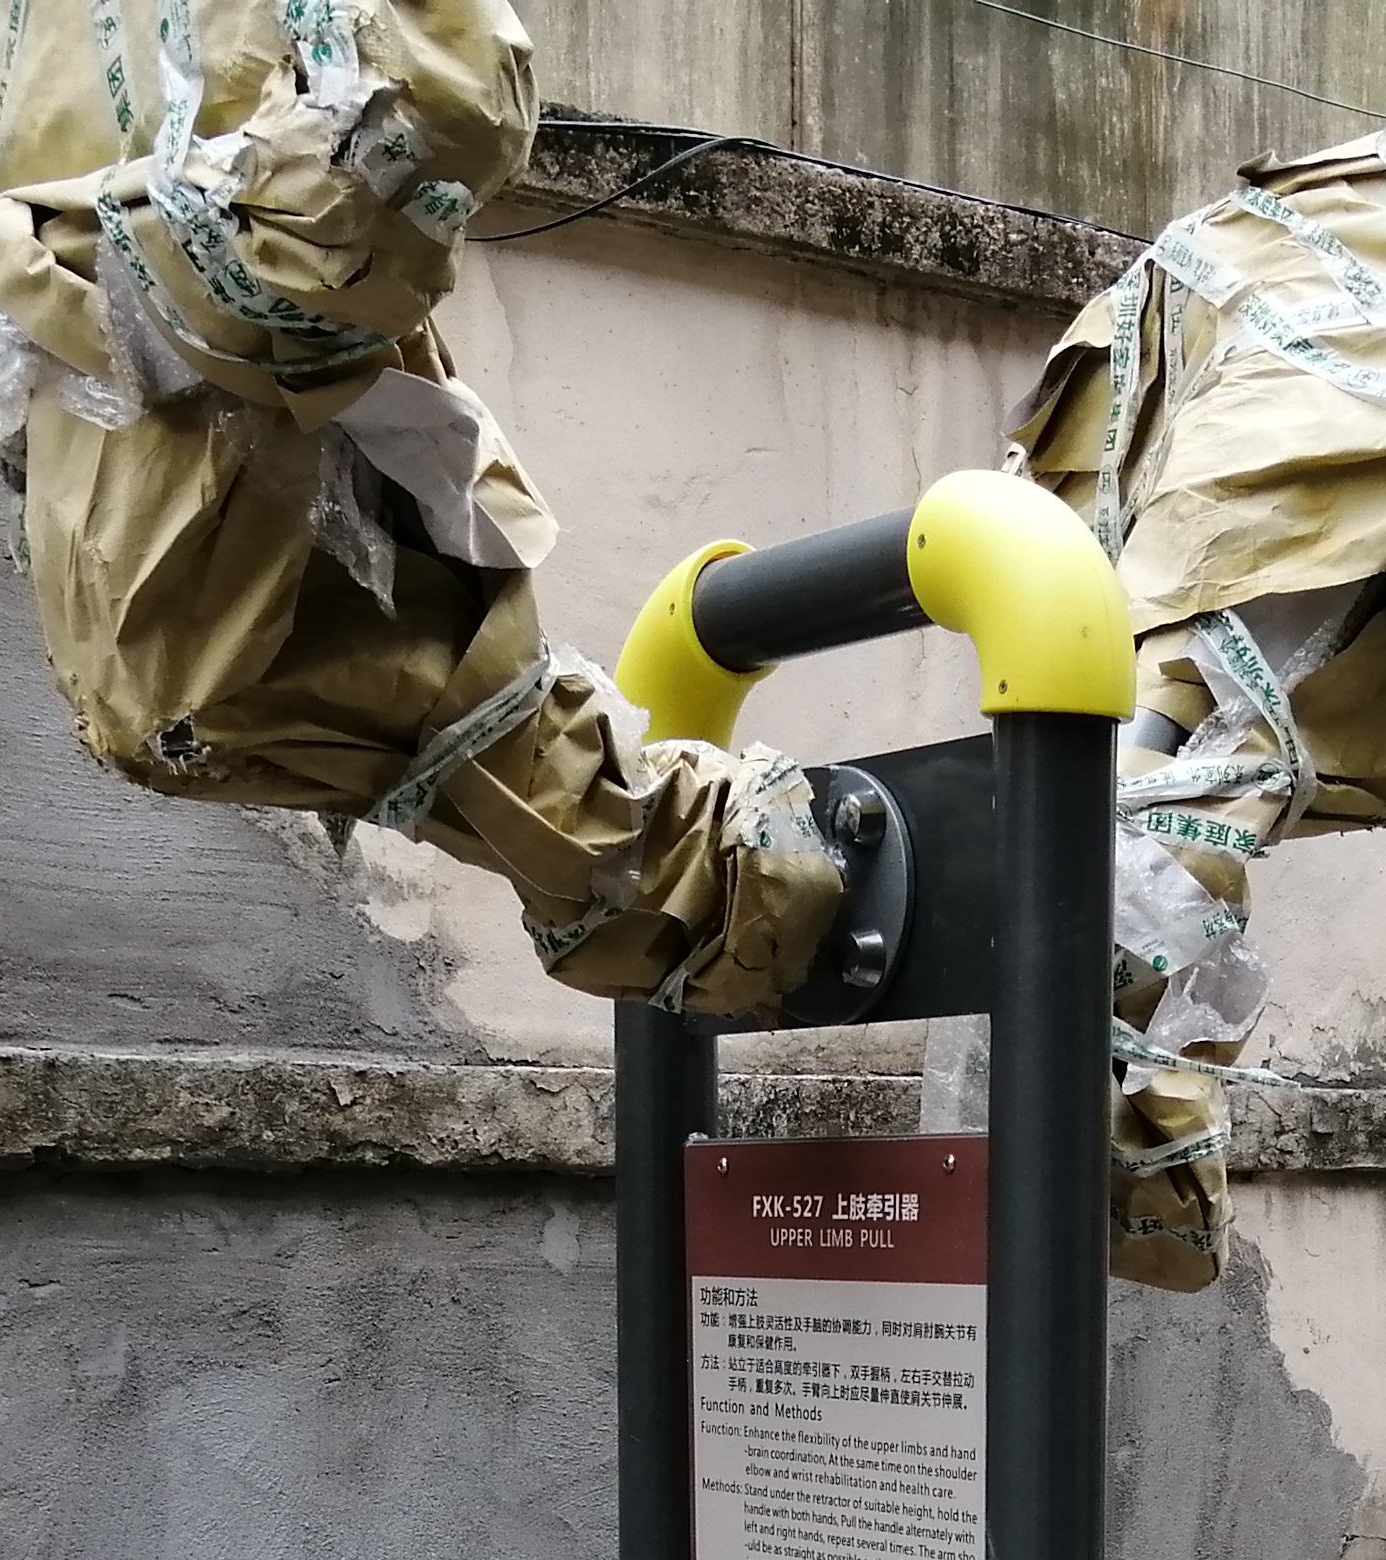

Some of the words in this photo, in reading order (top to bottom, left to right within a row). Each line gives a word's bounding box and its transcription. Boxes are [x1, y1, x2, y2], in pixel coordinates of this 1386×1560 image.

[1147, 811, 1258, 857] 家庭集团
[752, 1195, 824, 1218] FXK-527
[831, 1193, 920, 1222] 上肢牵引器
[770, 1228, 813, 1247] UPPER
[819, 1229, 854, 1248] LIMB
[860, 1229, 895, 1248] PULL
[700, 1286, 759, 1307] 功能和方法
[700, 1395, 745, 1414] Function
[749, 1401, 769, 1417] and
[774, 1401, 822, 1422] Methods
[700, 1419, 742, 1437] Function:
[743, 1424, 780, 1441] Enhance
[781, 1428, 796, 1443] the
[797, 1429, 841, 1451] flexibility
[841, 1434, 852, 1448] of
[853, 1435, 869, 1450] the
[870, 1440, 899, 1455] upper
[900, 1440, 928, 1456] limbs
[929, 1444, 949, 1458] and
[950, 1444, 976, 1461] hand
[744, 1462, 771, 1477] elbow
[772, 1466, 790, 1480] and
[790, 1468, 813, 1483] wrist
[814, 1470, 877, 1490] rehabilitation
[878, 1478, 897, 1493] and
[898, 1479, 930, 1497] health
[931, 1487, 956, 1499] care.
[769, 1448, 827, 1466] coordination,
[828, 1452, 839, 1466] At
[839, 1454, 855, 1468] the
[855, 1458, 880, 1471] same
[880, 1458, 902, 1474] time
[902, 1463, 916, 1475] on
[916, 1462, 933, 1477] the
[934, 1464, 978, 1481] shoulder
[701, 1476, 743, 1494] Methods:
[744, 1482, 768, 1498] Stand
[769, 1487, 795, 1501] under
[796, 1489, 811, 1503] the
[812, 1493, 851, 1508] retractor
[852, 1495, 862, 1510] of
[863, 1498, 900, 1515] suitable
[901, 1501, 935, 1521] height,
[937, 1505, 959, 1522] hold
[960, 1509, 978, 1525] the
[743, 1500, 771, 1517] handle
[771, 1505, 790, 1519] with
[790, 1506, 811, 1522] both
[811, 1509, 839, 1527] hands,
[840, 1513, 857, 1529] Pull
[857, 1515, 873, 1531] the
[873, 1517, 904, 1535] handle
[905, 1522, 953, 1545] alternately
[953, 1529, 975, 1545] with
[743, 1519, 758, 1533] left
[758, 1523, 775, 1536] and
[776, 1524, 796, 1541] right
[797, 1526, 825, 1545] hands,
[826, 1534, 855, 1549] repeat
[856, 1538, 888, 1552] several
[888, 1539, 917, 1556] times.
[917, 1543, 936, 1559] The
